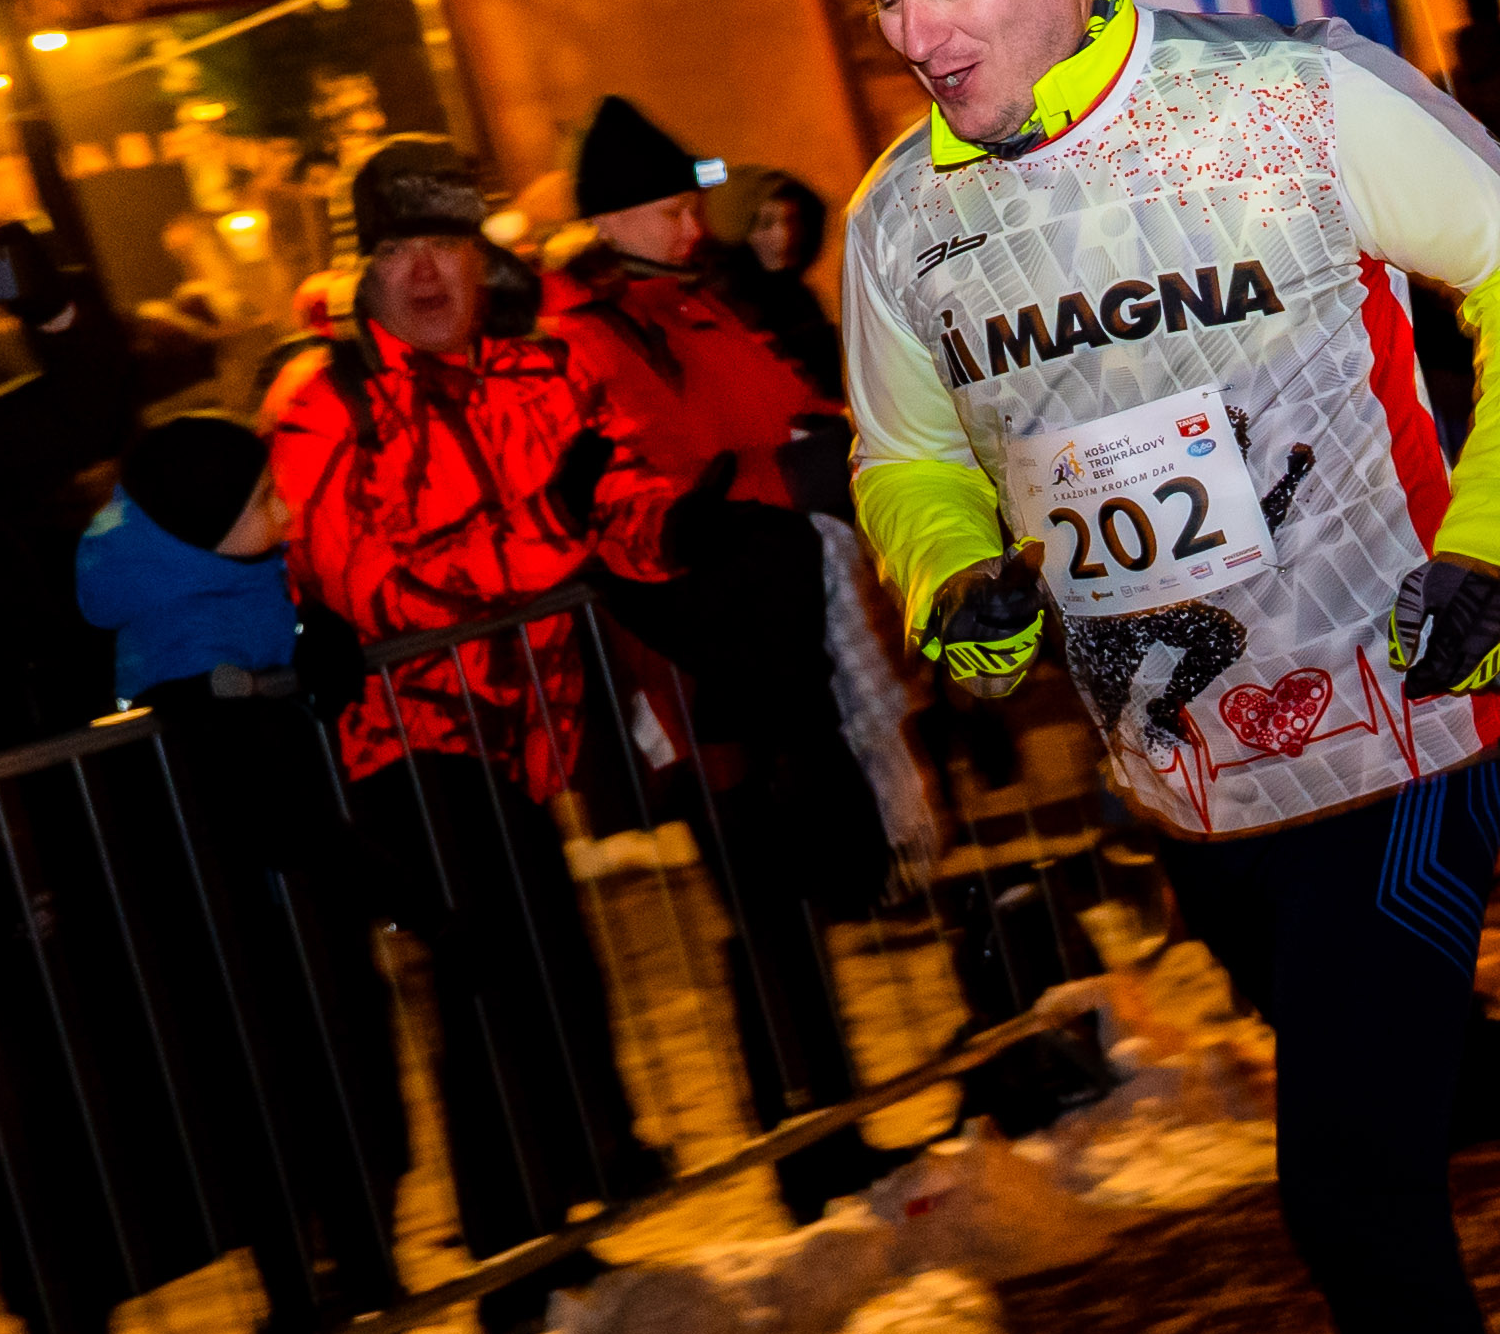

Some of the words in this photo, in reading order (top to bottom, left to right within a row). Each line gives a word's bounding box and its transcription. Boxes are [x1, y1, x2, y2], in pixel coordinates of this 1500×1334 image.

[984, 259, 1286, 378] MAGNA
[1084, 435, 1131, 459] KOŠICKÝ
[1088, 435, 1165, 469] TROJKRÁĽOVÝ
[1092, 467, 1115, 480] BEH
[1101, 472, 1148, 493] KROKOM
[1152, 462, 1175, 477] DAR
[1048, 475, 1228, 580] 202
